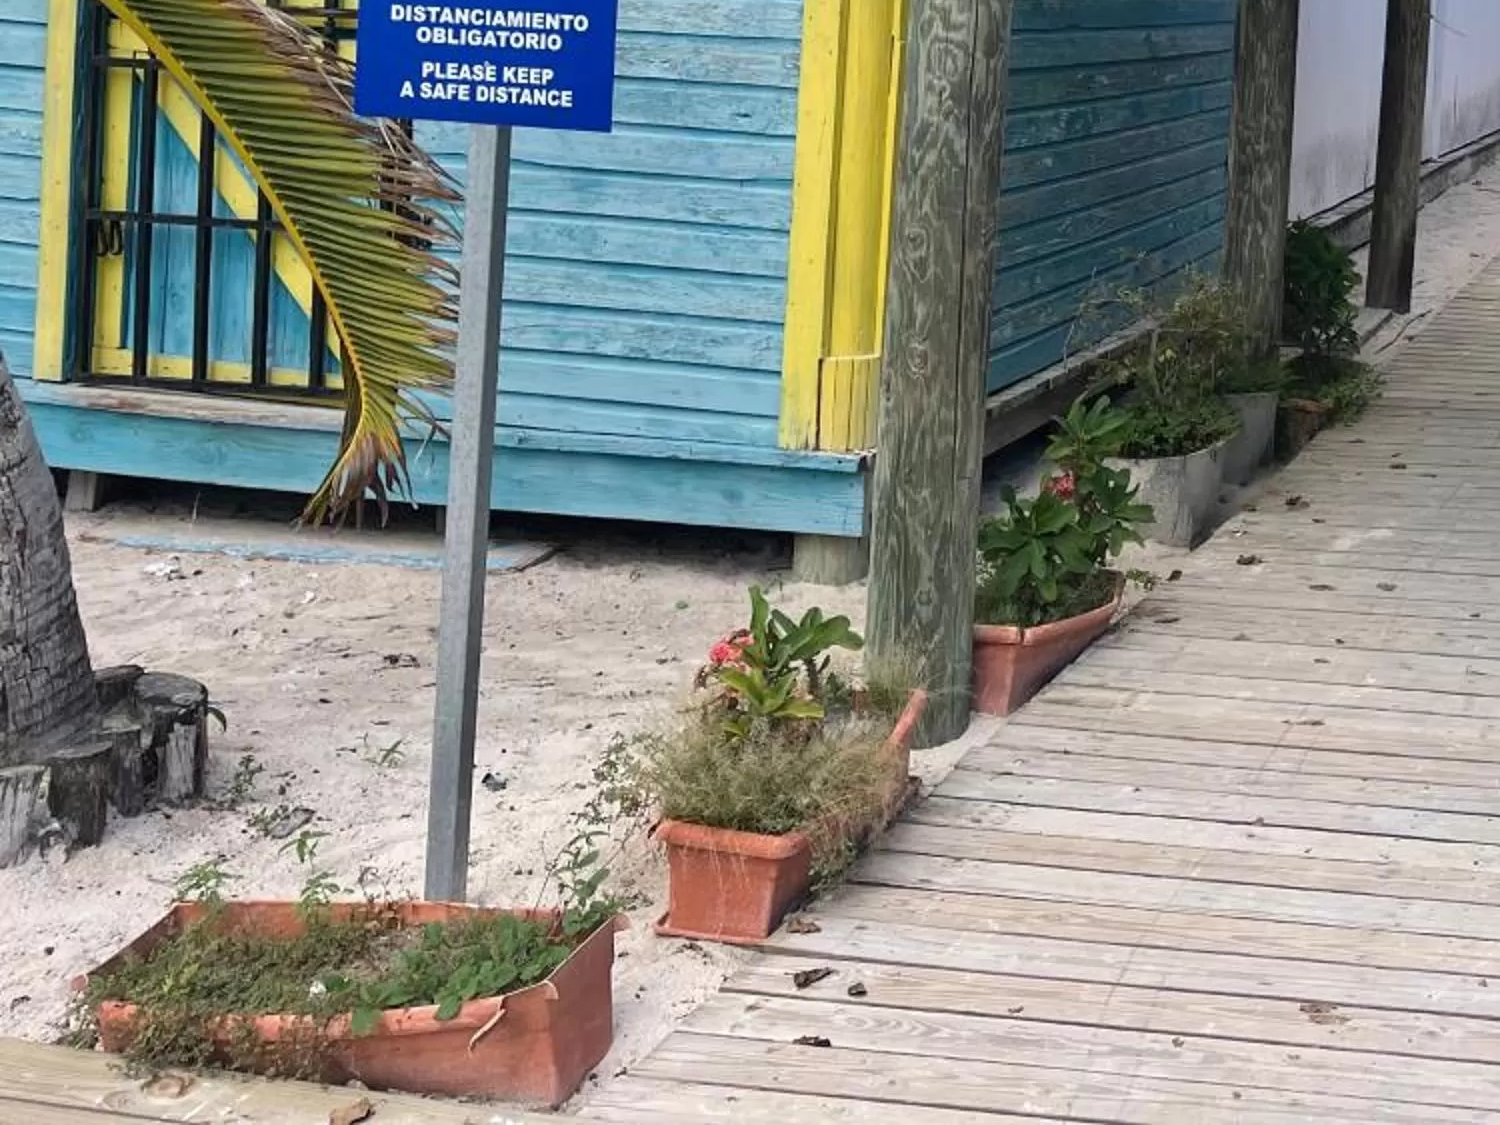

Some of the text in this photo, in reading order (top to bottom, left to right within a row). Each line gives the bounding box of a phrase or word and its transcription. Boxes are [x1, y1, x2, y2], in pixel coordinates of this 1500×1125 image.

[390, 4, 589, 32] DISTANCIAMIENTO
[415, 26, 563, 51] OBLIGATORIO
[421, 61, 554, 86] PLEASE KEEP
[399, 80, 573, 108] A SAFE DISTANCE
